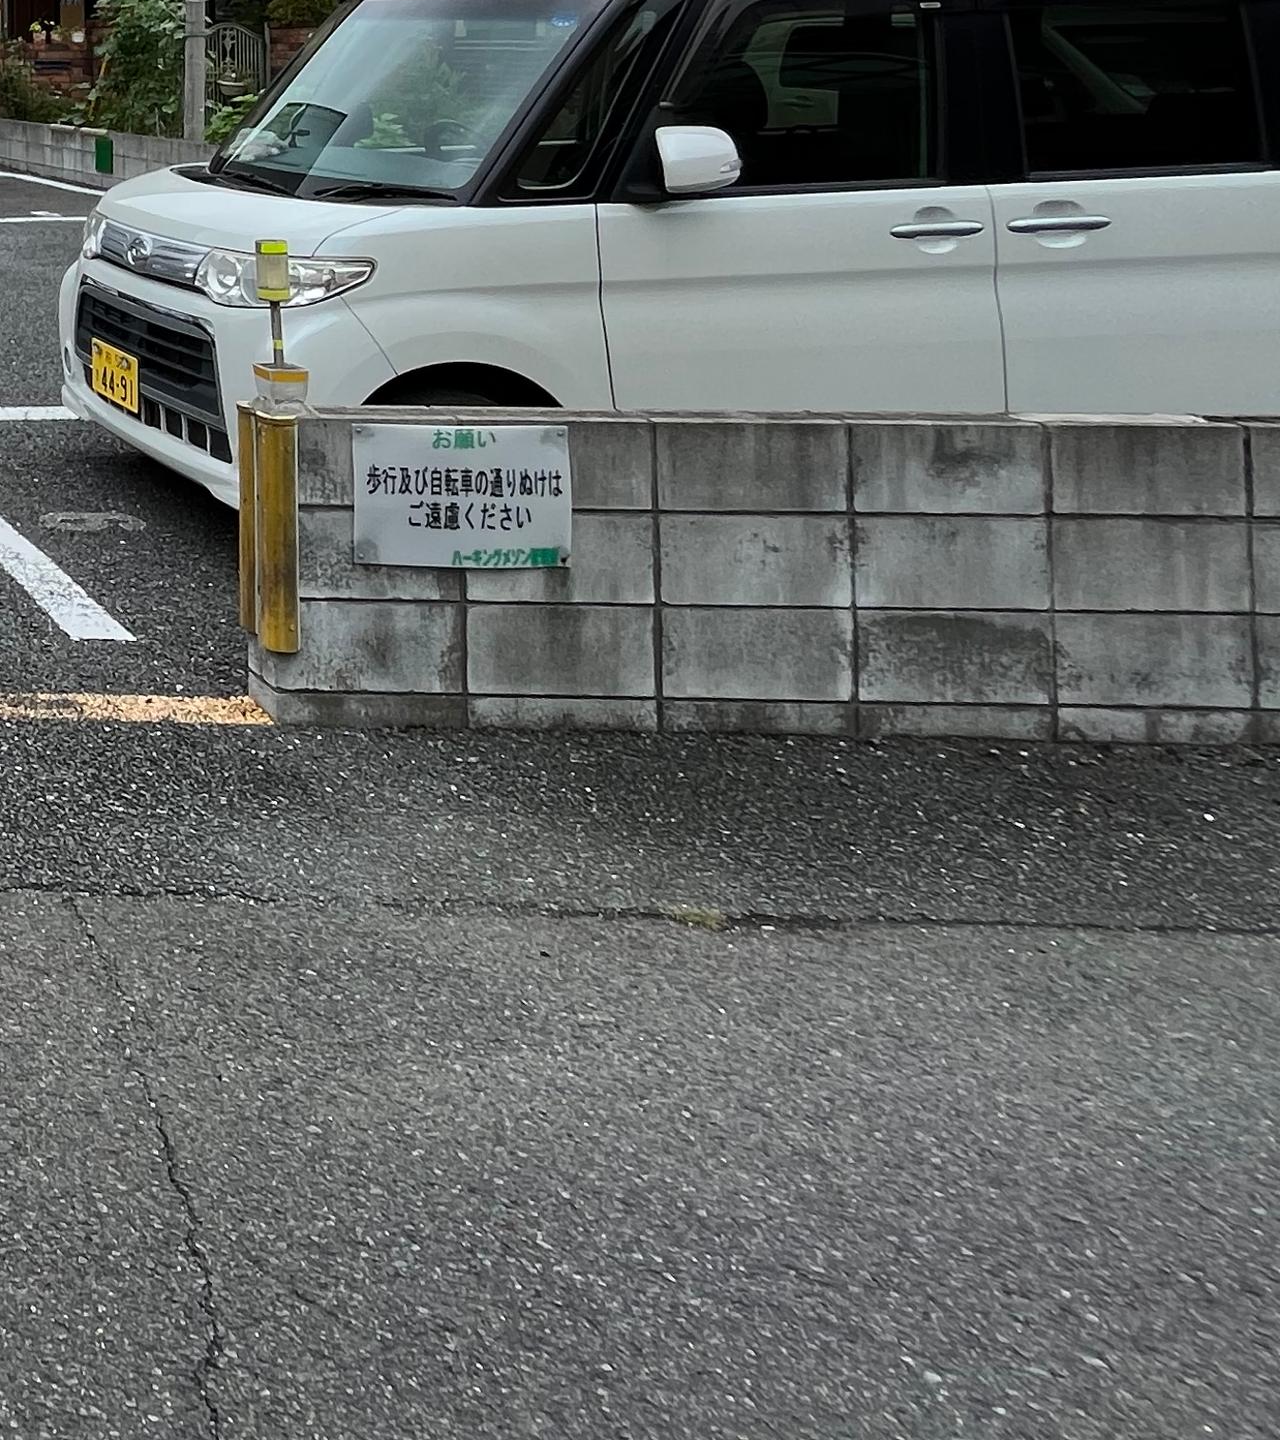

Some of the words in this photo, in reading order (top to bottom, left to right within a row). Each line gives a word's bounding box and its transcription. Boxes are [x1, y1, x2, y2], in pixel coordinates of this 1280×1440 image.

[432, 428, 496, 450] お願い
[366, 463, 563, 498] 歩行及び自転車の通りぬけは
[408, 501, 532, 531] ご遠慮ください
